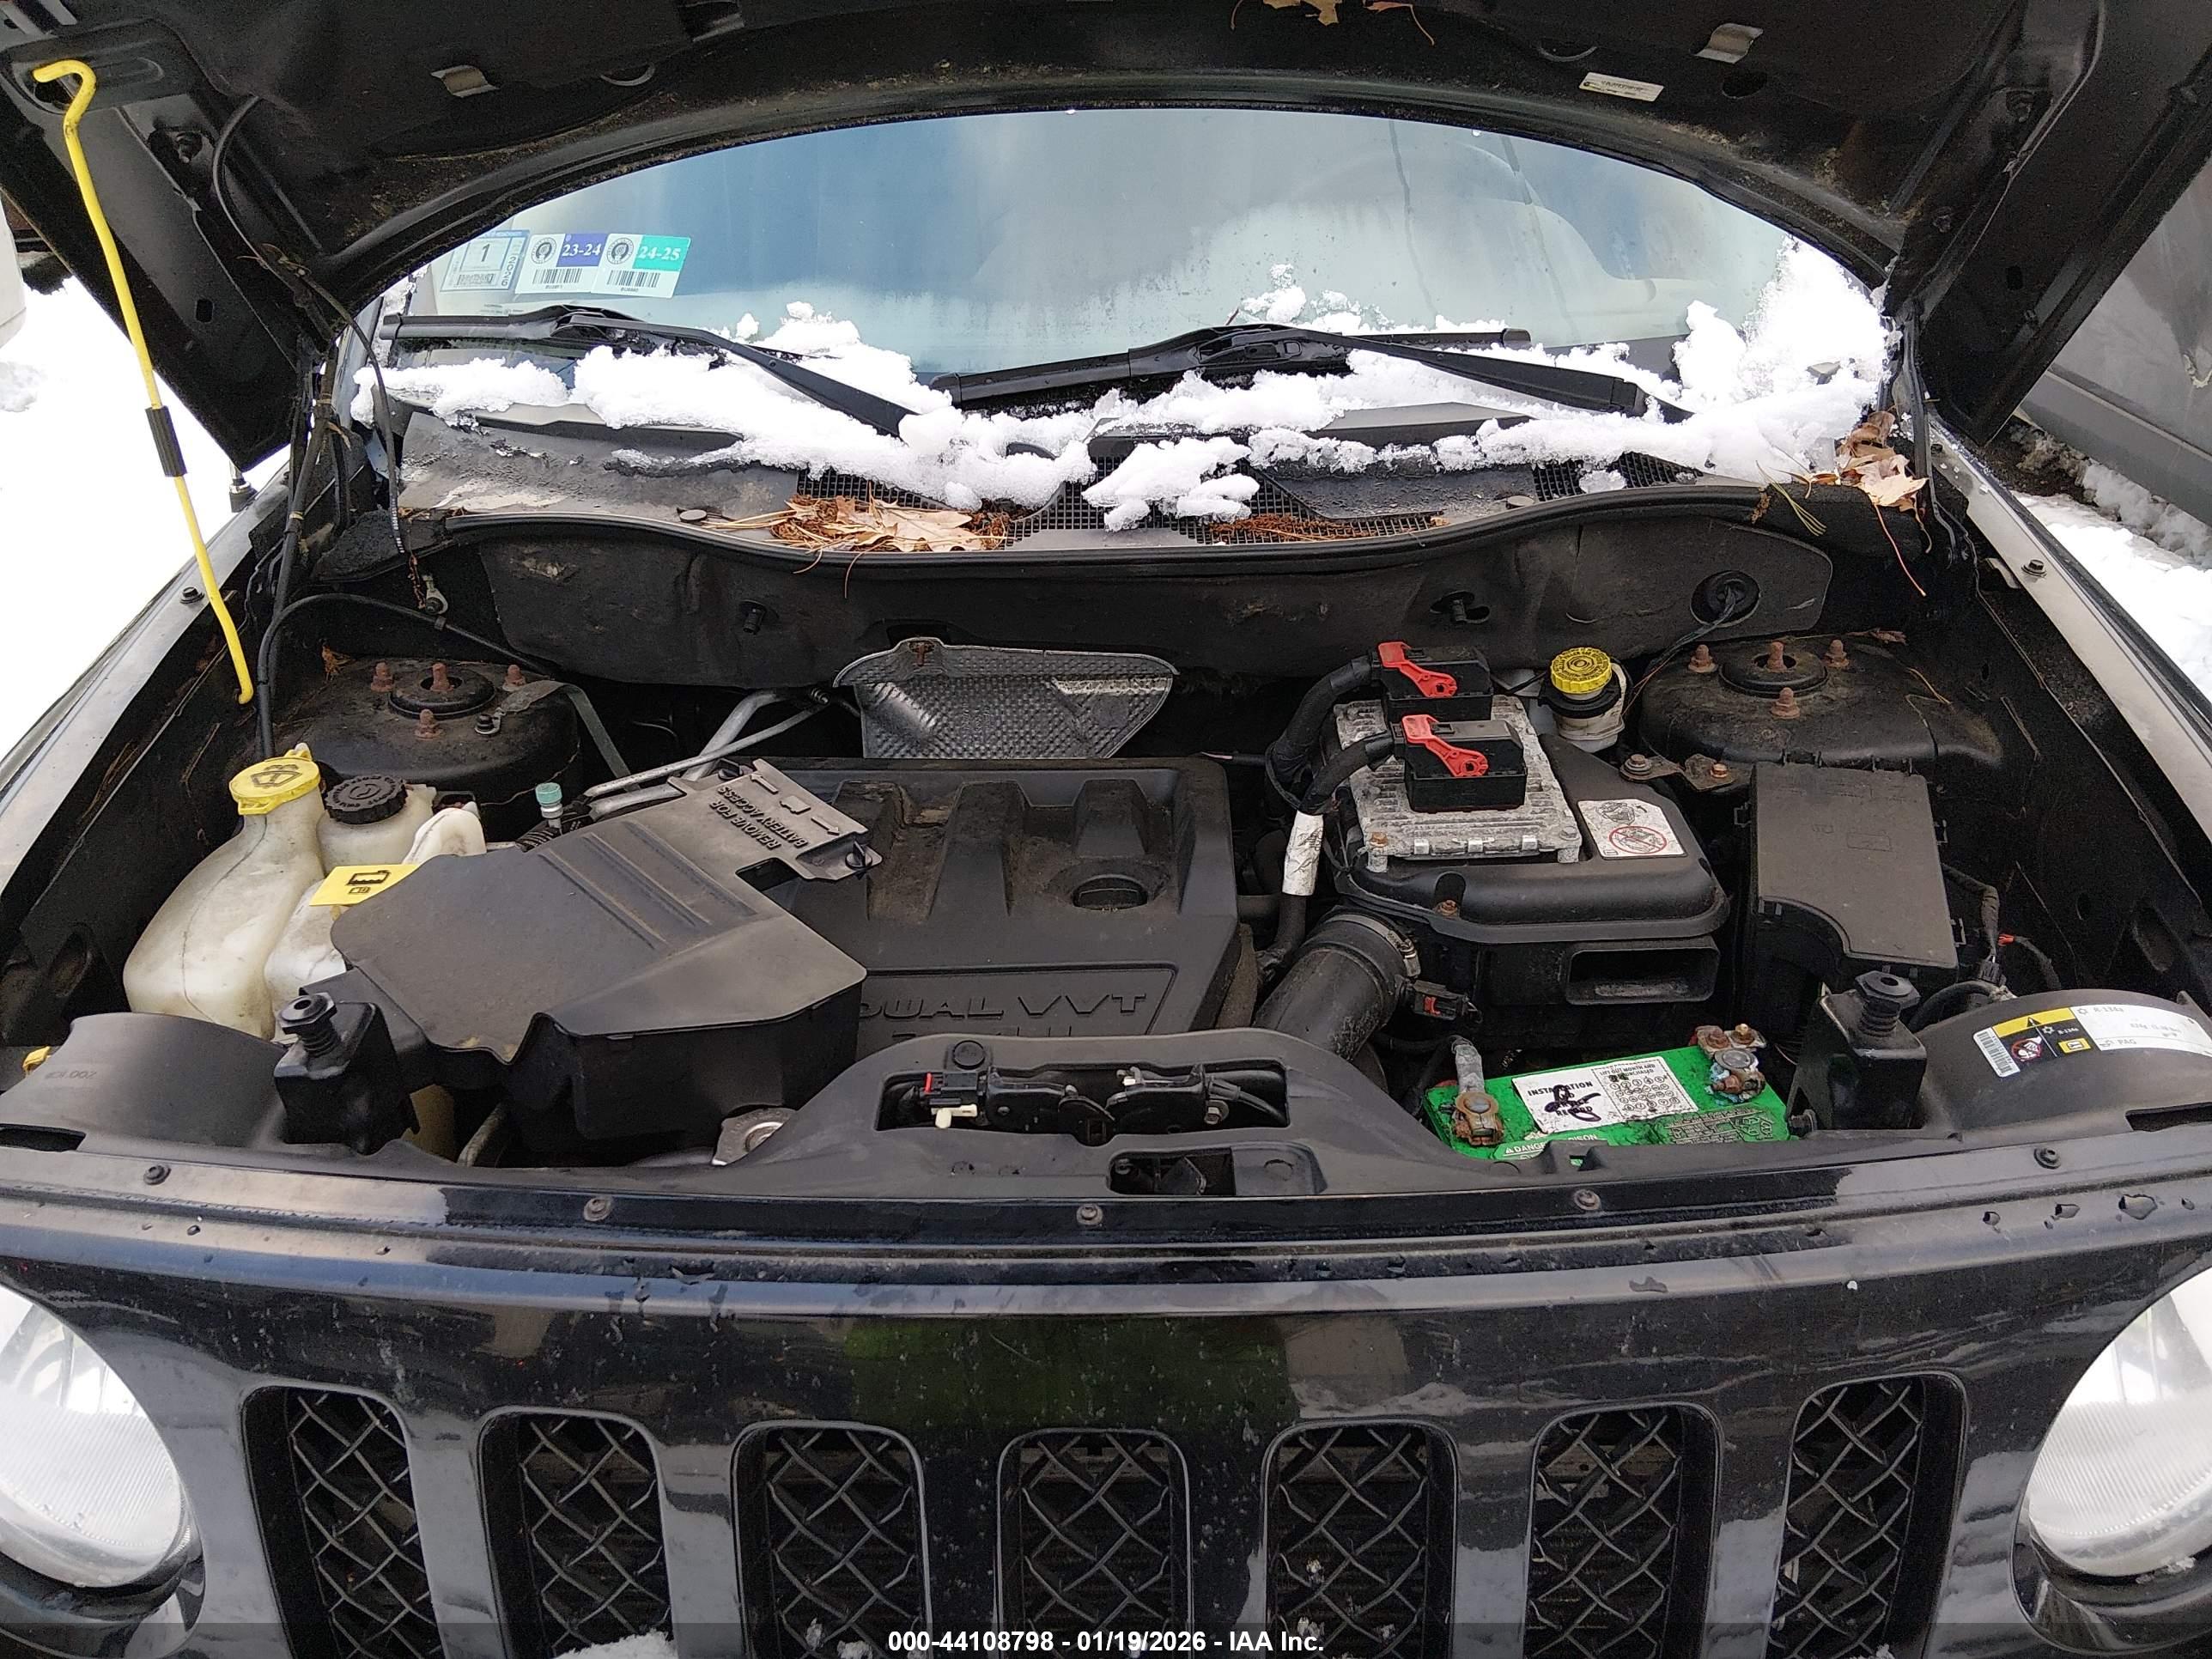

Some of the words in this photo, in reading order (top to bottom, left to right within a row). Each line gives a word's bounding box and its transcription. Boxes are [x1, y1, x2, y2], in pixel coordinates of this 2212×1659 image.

[480, 243, 490, 263] 1
[562, 243, 602, 257] 23-24
[637, 246, 682, 261] 24-25
[501, 256, 516, 287] 2026
[709, 799, 738, 819] FOR
[717, 787, 764, 817] ACCESS
[731, 816, 781, 850] REMOVE
[757, 816, 808, 848] BATTERY
[1018, 993, 1148, 1017] VVT
[1528, 1081, 1594, 1097] INSTAATION
[1556, 1106, 1593, 1116] REORD
[1514, 1140, 1547, 1152] DANGE
